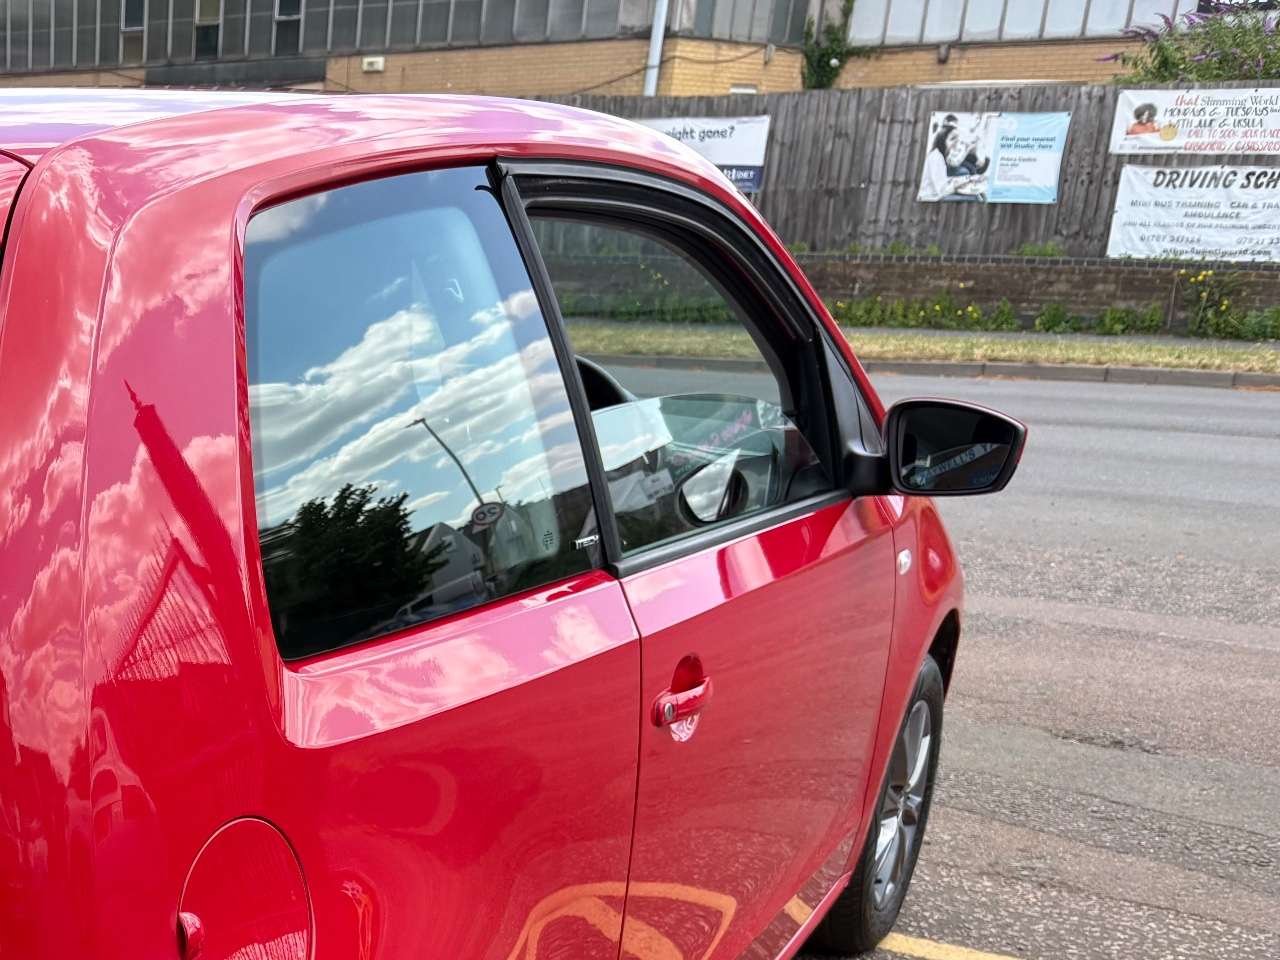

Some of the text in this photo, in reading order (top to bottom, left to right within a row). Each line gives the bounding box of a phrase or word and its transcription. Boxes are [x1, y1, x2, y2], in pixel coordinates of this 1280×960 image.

[1200, 96, 1247, 107] Slimming
[1250, 95, 1280, 106] World
[699, 125, 736, 142] gone?
[1152, 170, 1237, 189] DRIVING
